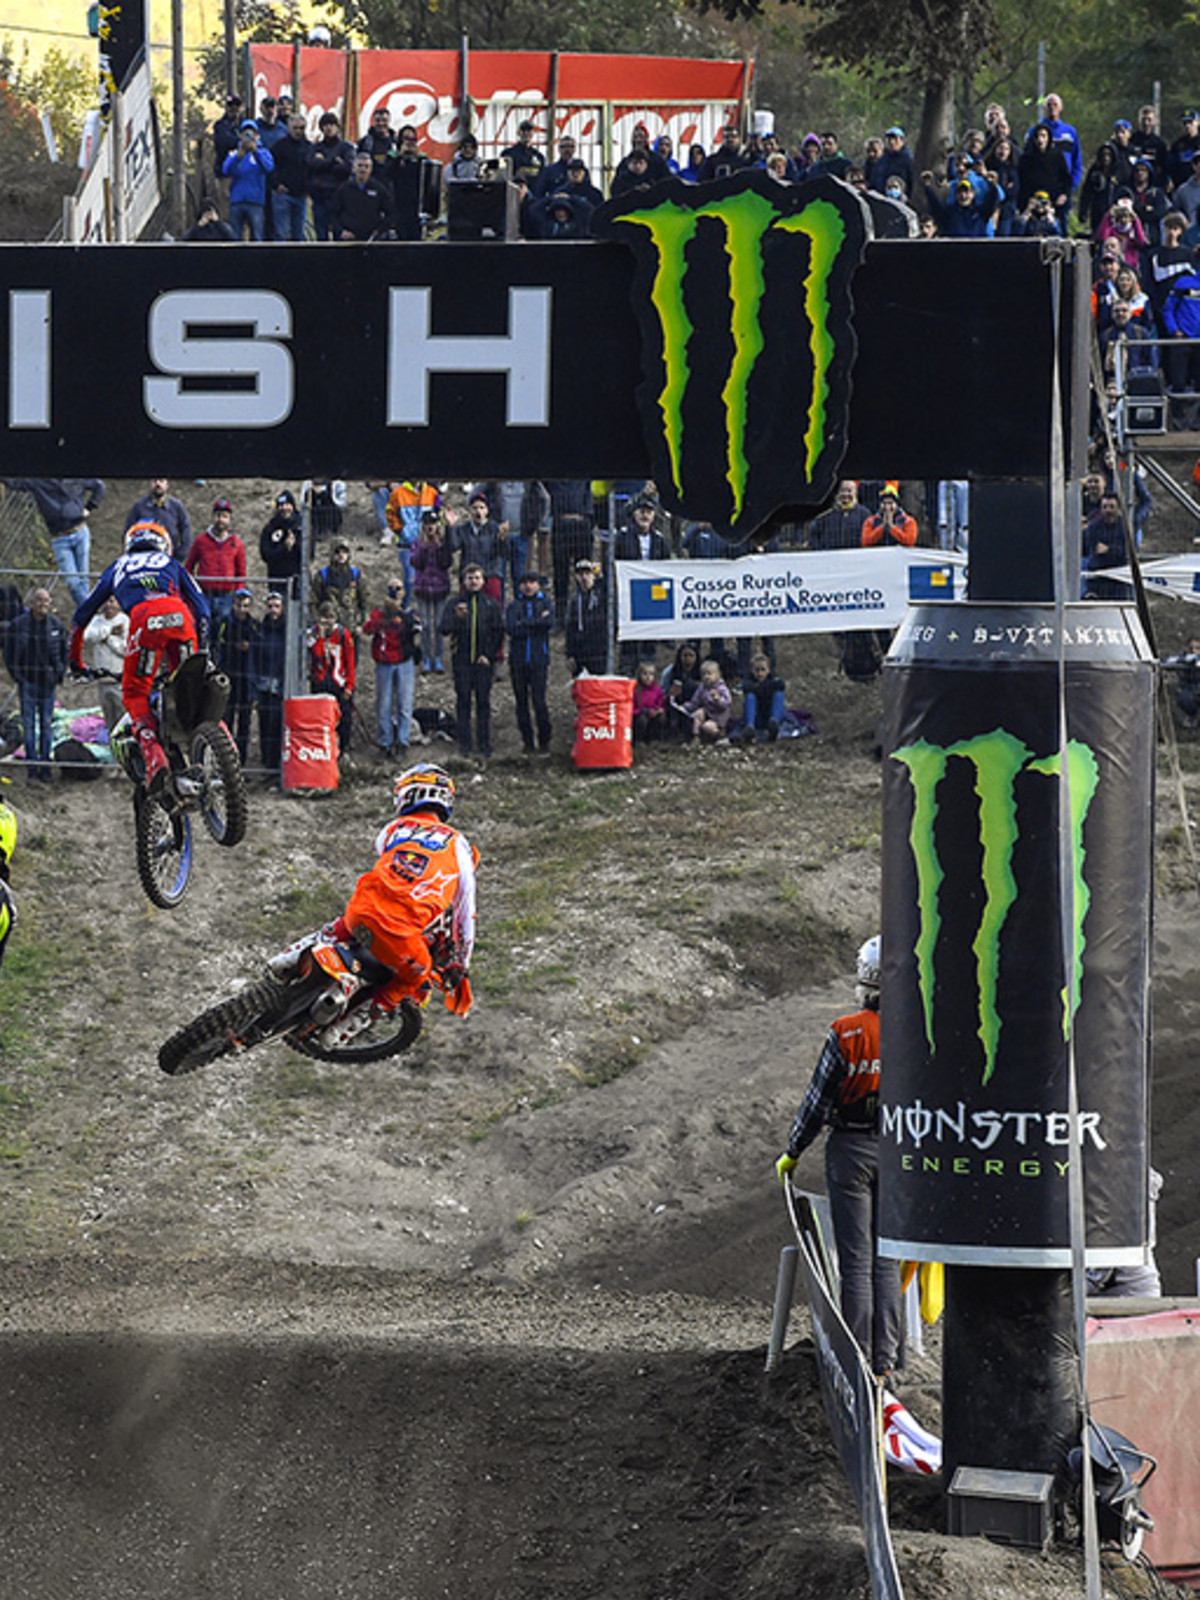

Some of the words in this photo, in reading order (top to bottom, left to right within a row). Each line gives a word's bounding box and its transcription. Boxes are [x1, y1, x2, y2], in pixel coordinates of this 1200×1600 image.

[681, 576, 740, 595] Cassa
[742, 571, 803, 591] Rurale
[681, 590, 782, 612] AltoGarda
[799, 588, 883, 606] Rovereto
[583, 725, 615, 740] SVAI
[298, 746, 331, 761] SVAI
[881, 1100, 1107, 1151] MONSTER
[901, 1154, 1070, 1177] ENERGY
